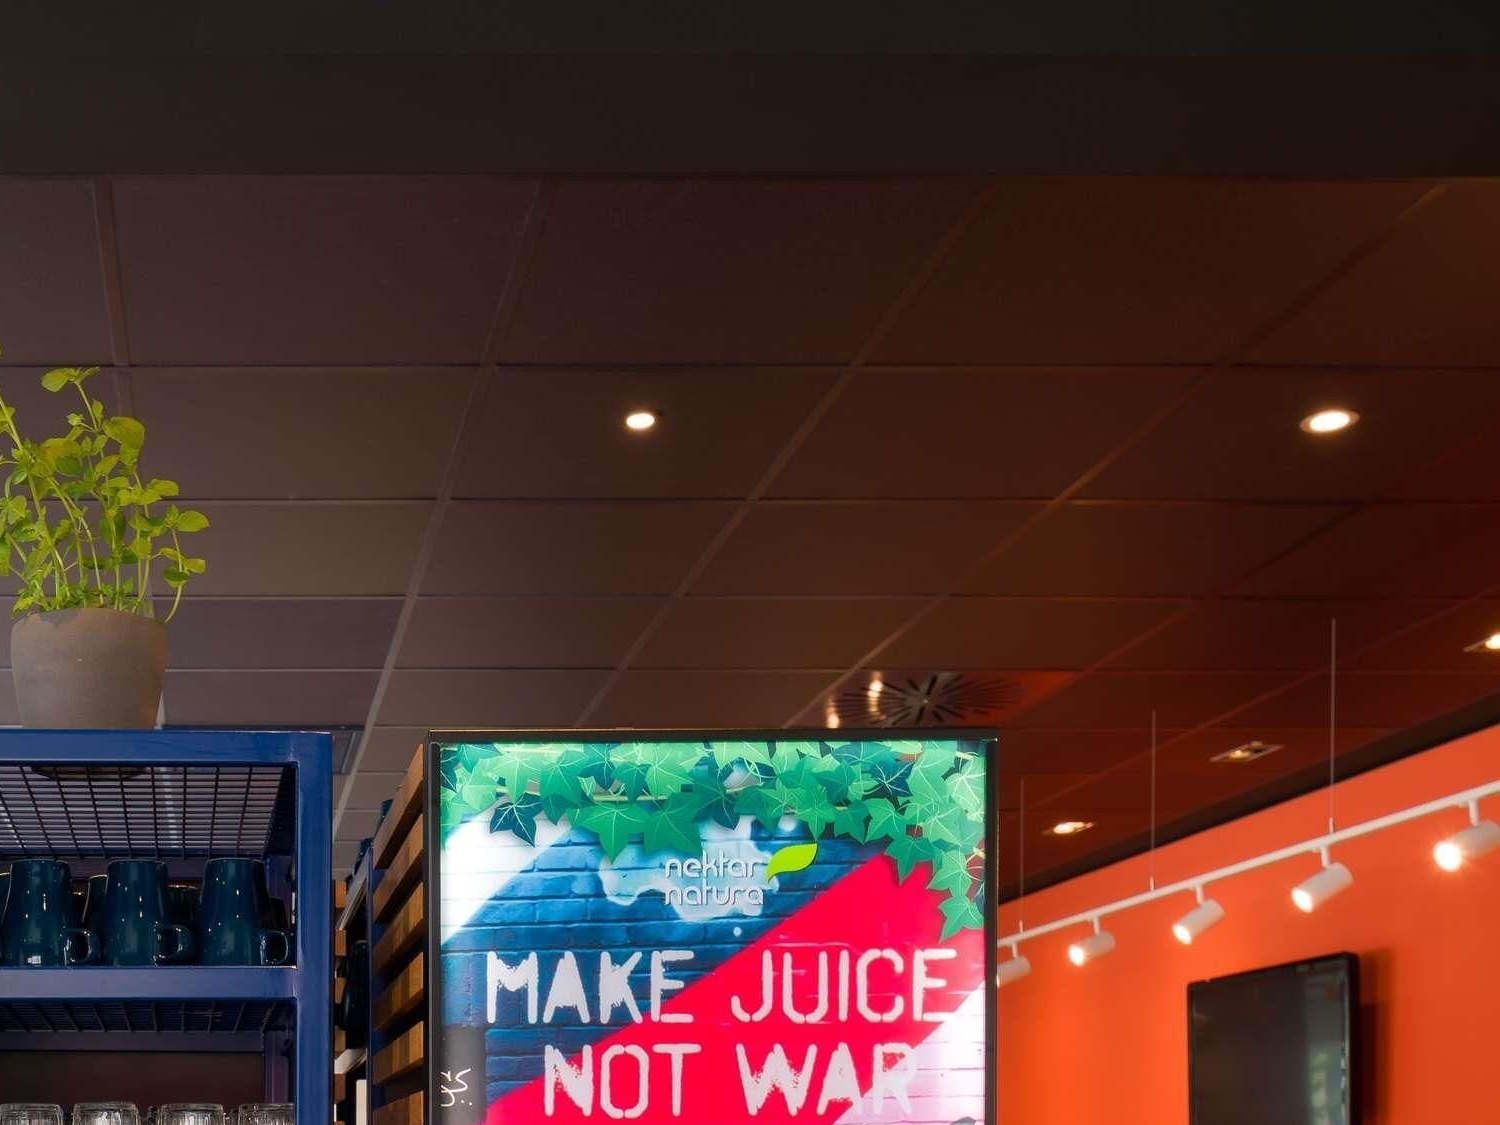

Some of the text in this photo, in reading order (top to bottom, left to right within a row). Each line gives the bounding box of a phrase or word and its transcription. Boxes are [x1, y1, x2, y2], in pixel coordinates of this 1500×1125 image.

[664, 848, 758, 879] nektar
[664, 878, 764, 906] natura
[486, 948, 958, 1024] MAKE JUICE
[543, 1043, 703, 1120] NOT
[734, 1042, 919, 1118] WAR
